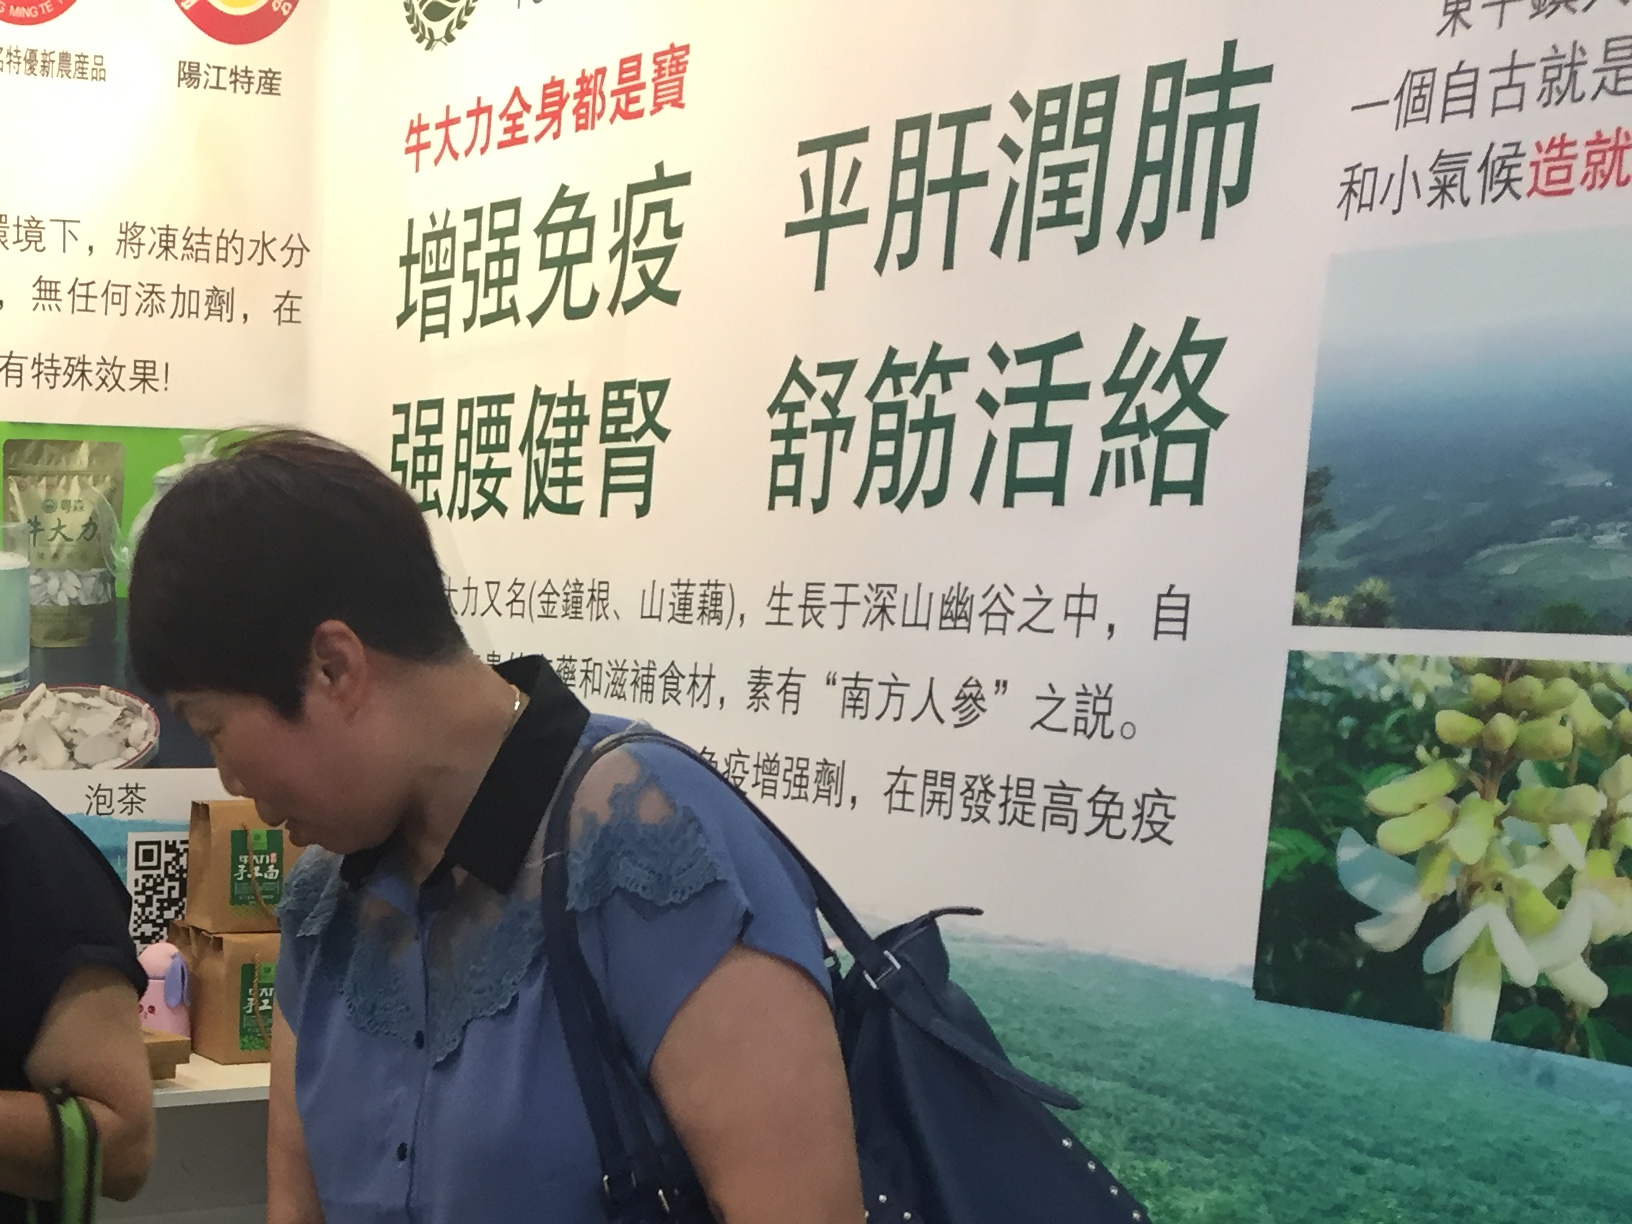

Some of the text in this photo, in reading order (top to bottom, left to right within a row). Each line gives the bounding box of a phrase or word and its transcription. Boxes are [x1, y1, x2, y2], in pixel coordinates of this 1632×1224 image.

[177, 59, 283, 98] 陽江特産
[404, 43, 692, 174] 牛大力全身都是寶
[1350, 34, 1632, 132] 一個自古就是
[783, 38, 1275, 294] 平肝潤肺
[395, 159, 695, 343] 增强免疫
[389, 377, 673, 524] 强腰健腎
[766, 315, 1231, 515] 舒筋活絡
[27, 515, 100, 547] 牛大力
[84, 781, 148, 817] 泡茶
